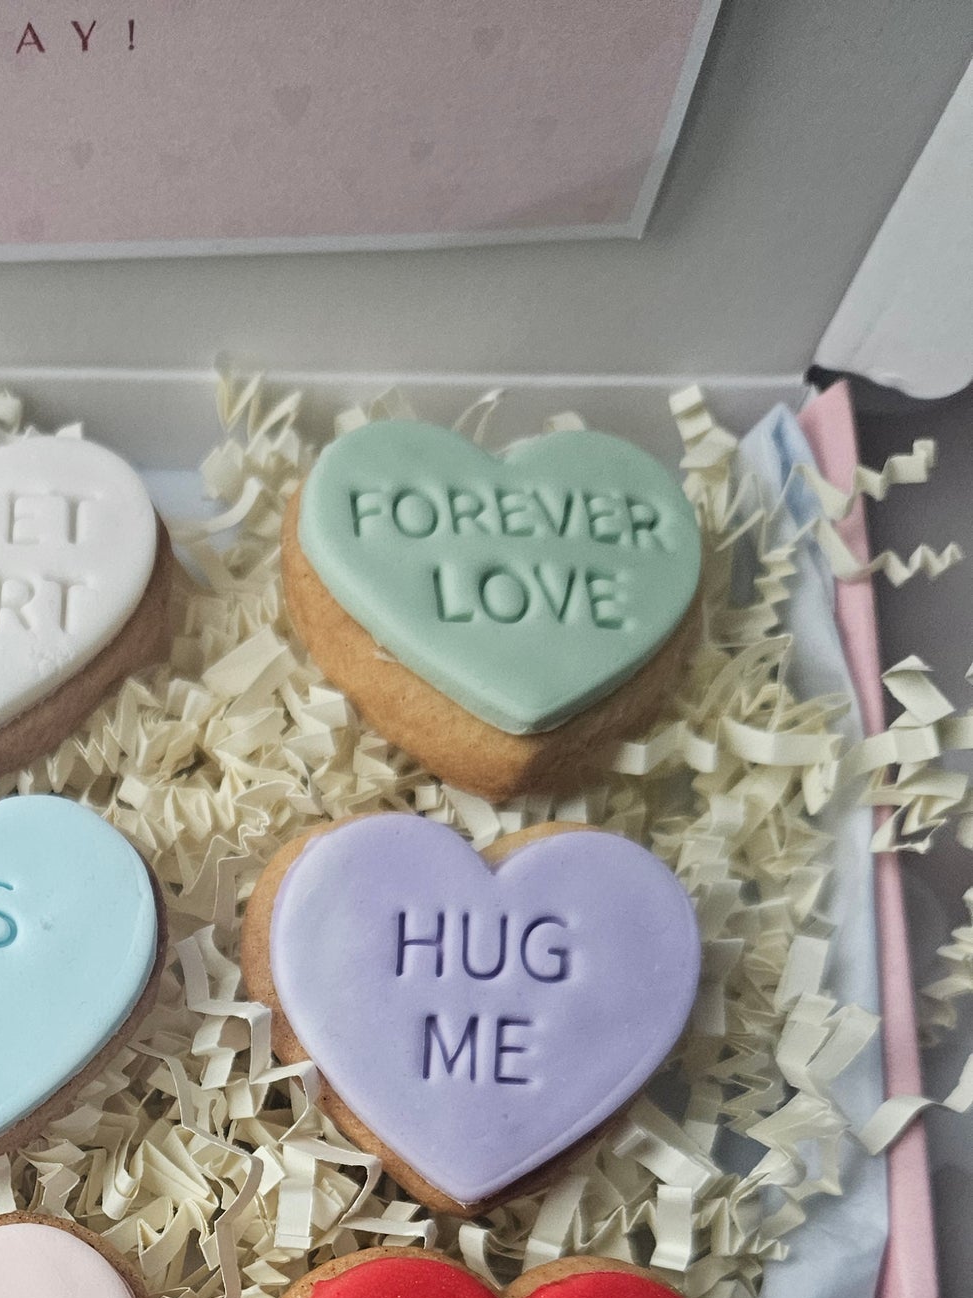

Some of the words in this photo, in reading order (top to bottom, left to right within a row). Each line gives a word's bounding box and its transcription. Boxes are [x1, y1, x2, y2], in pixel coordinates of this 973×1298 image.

[348, 487, 671, 551] FOREVER
[430, 565, 629, 630] LOVE
[393, 910, 572, 983] HUG
[421, 1013, 536, 1087] ME
